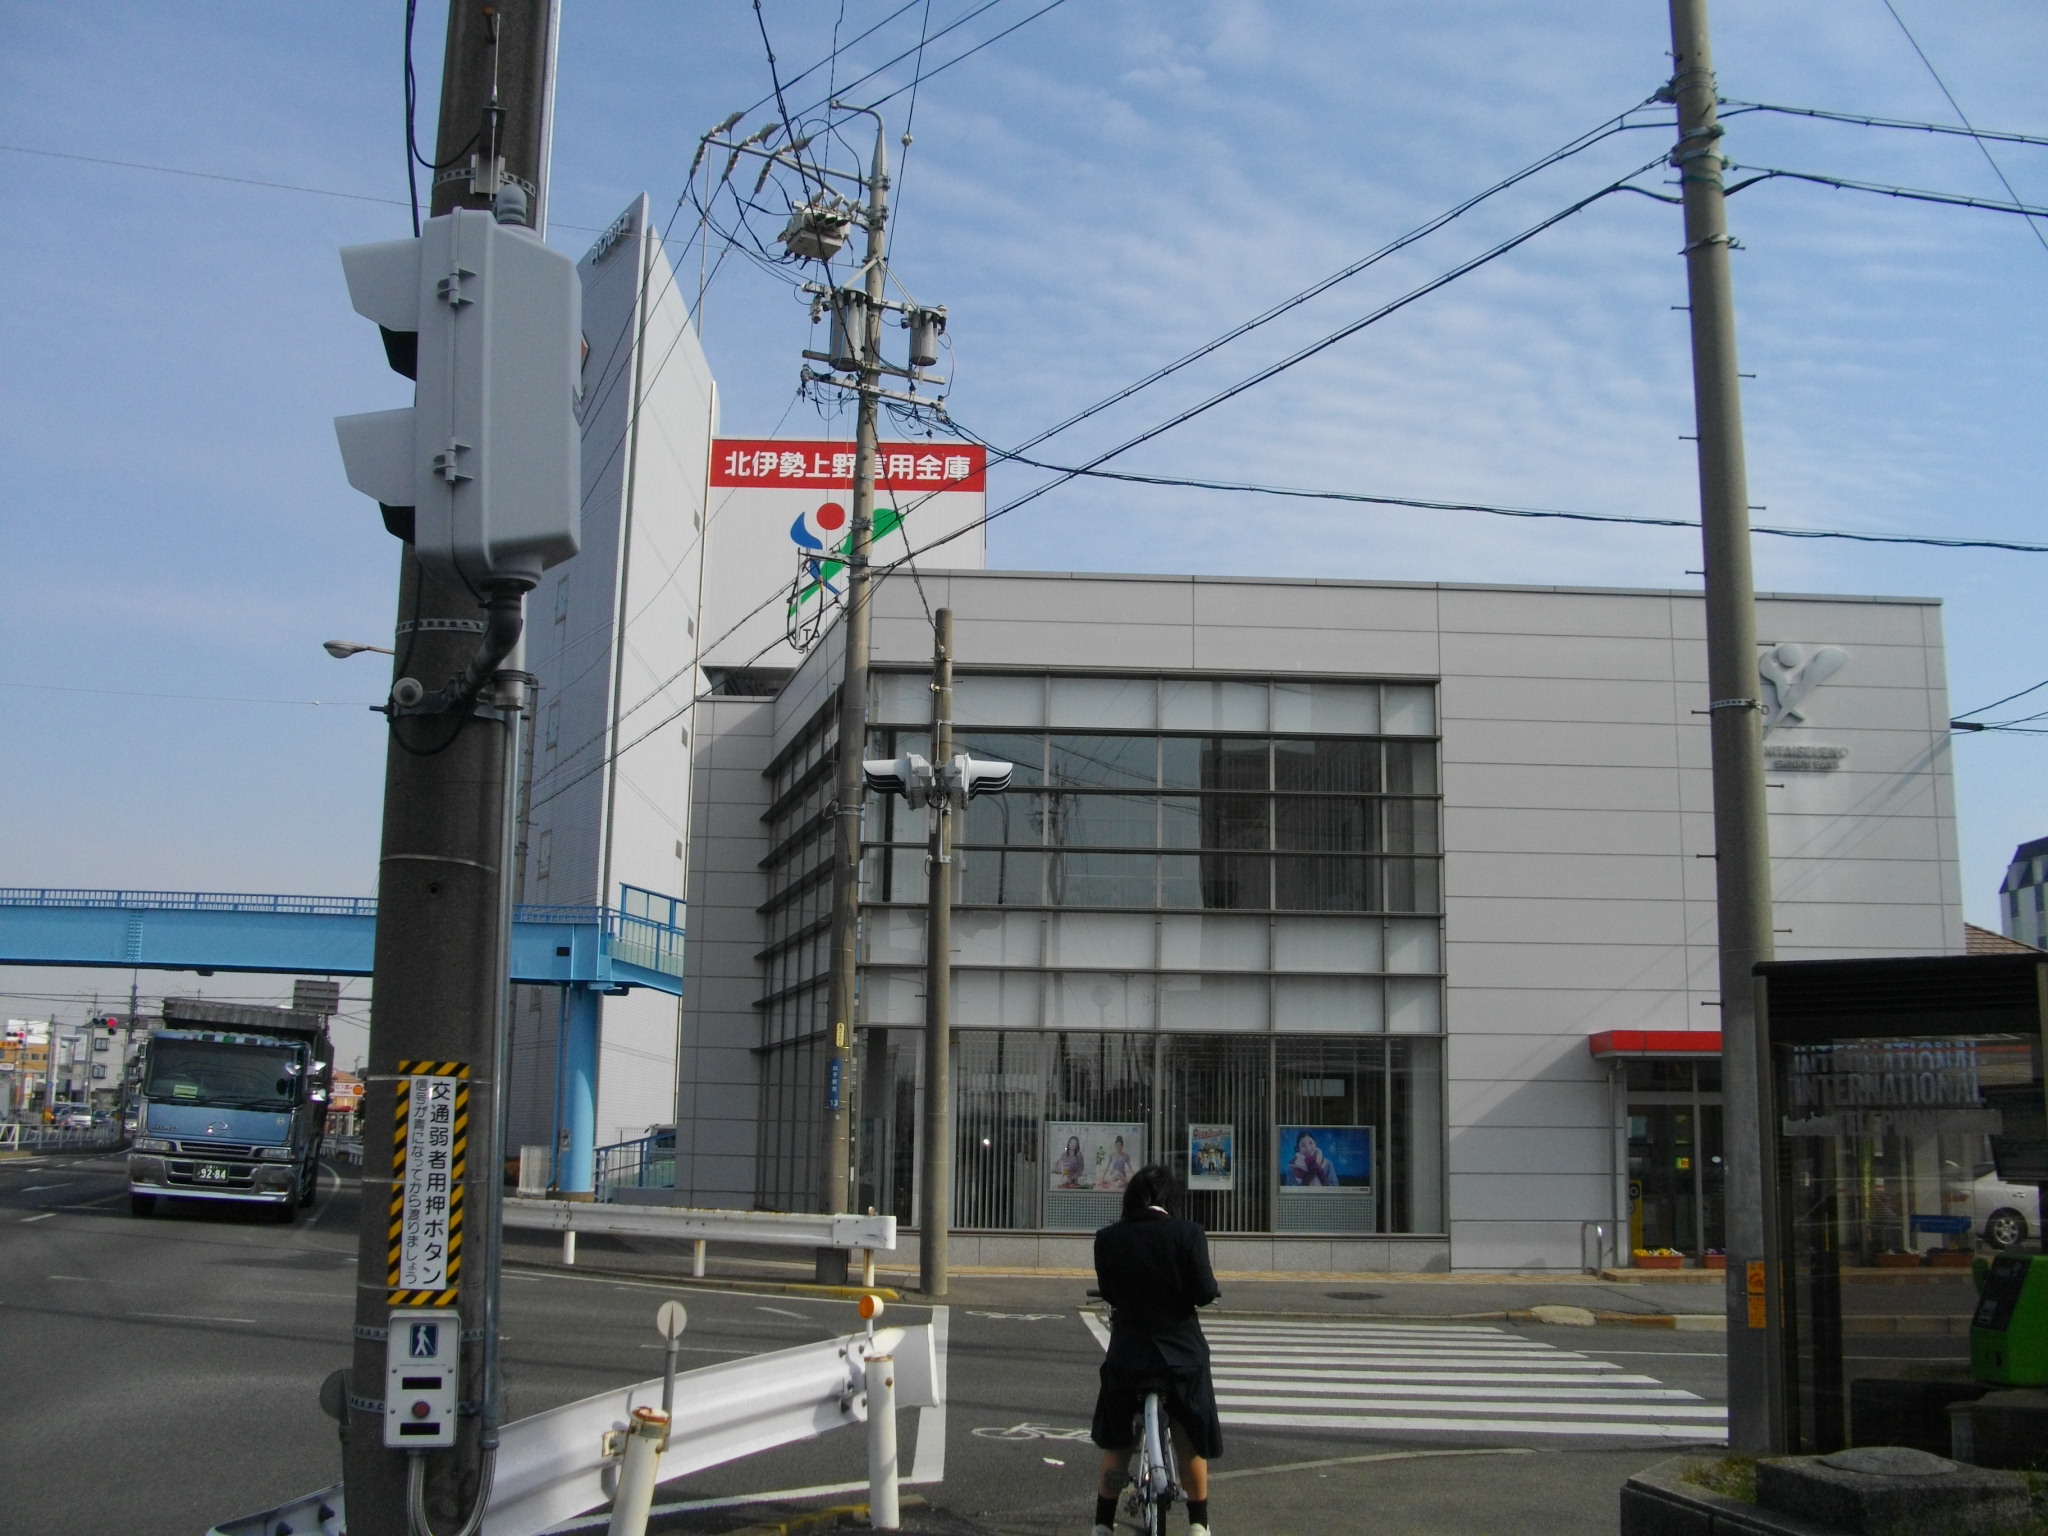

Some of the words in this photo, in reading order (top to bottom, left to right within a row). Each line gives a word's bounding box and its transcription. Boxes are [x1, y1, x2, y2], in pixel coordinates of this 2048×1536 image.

[405, 1078, 428, 1285] 信号が青になってから渡りましょう
[423, 1080, 451, 1285] 交通弱者用押ボタン
